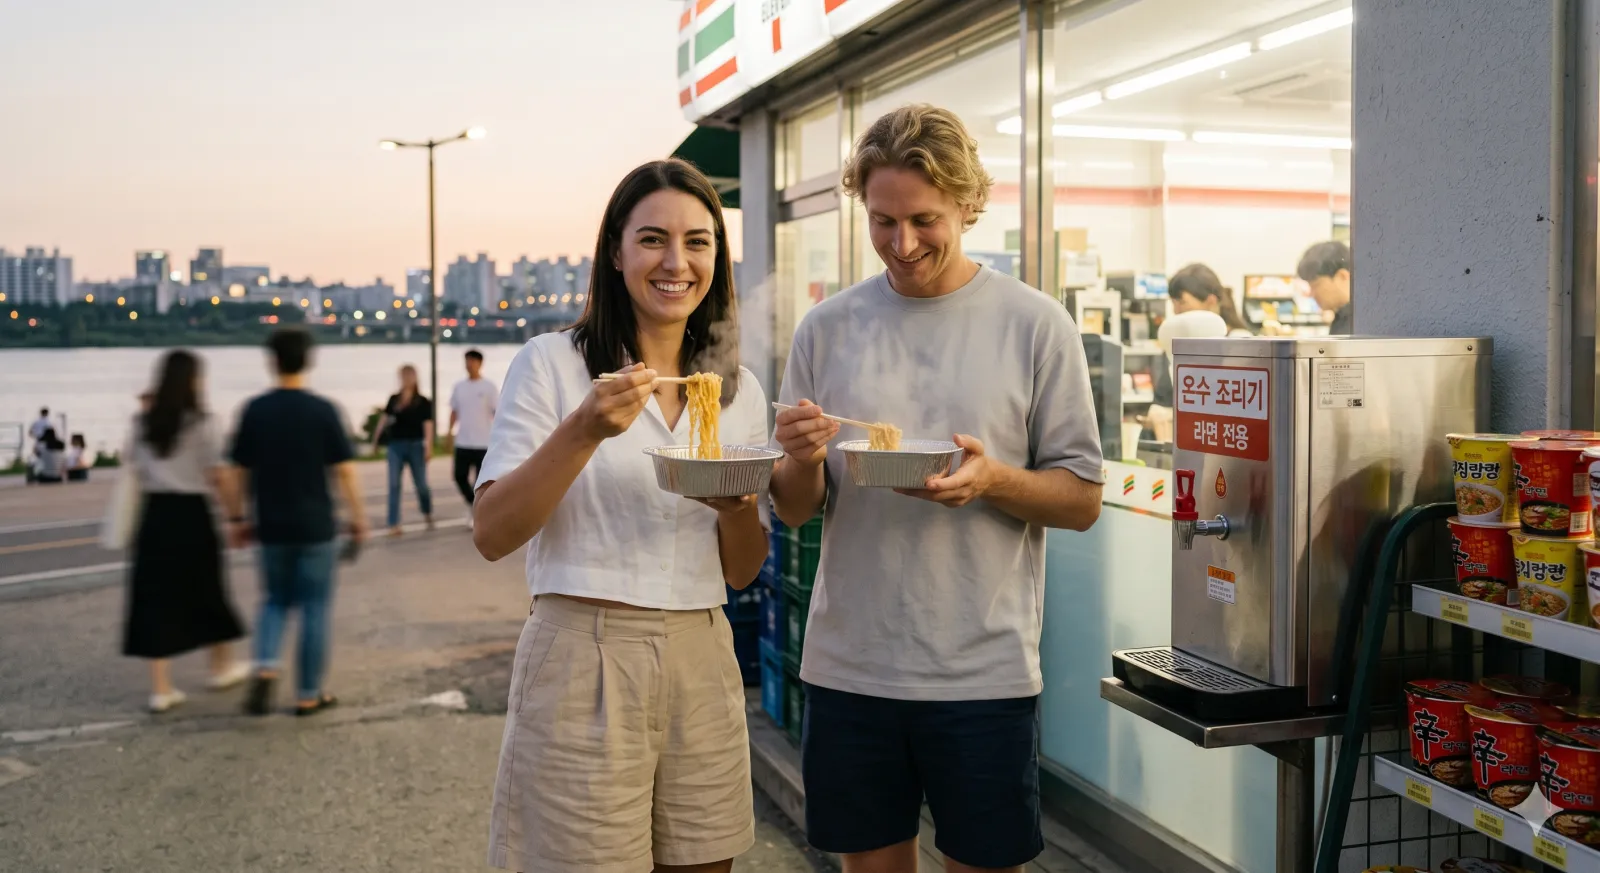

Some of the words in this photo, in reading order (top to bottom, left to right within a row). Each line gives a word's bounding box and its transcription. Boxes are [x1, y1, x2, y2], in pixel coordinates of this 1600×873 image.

[1182, 375, 1210, 406] 온수
[1216, 378, 1263, 412] 조리기
[1193, 420, 1218, 447] 라면
[1222, 423, 1249, 451] 전용
[1412, 708, 1449, 761] 辛
[1472, 728, 1507, 786] 辛
[1538, 751, 1570, 811] 辛
